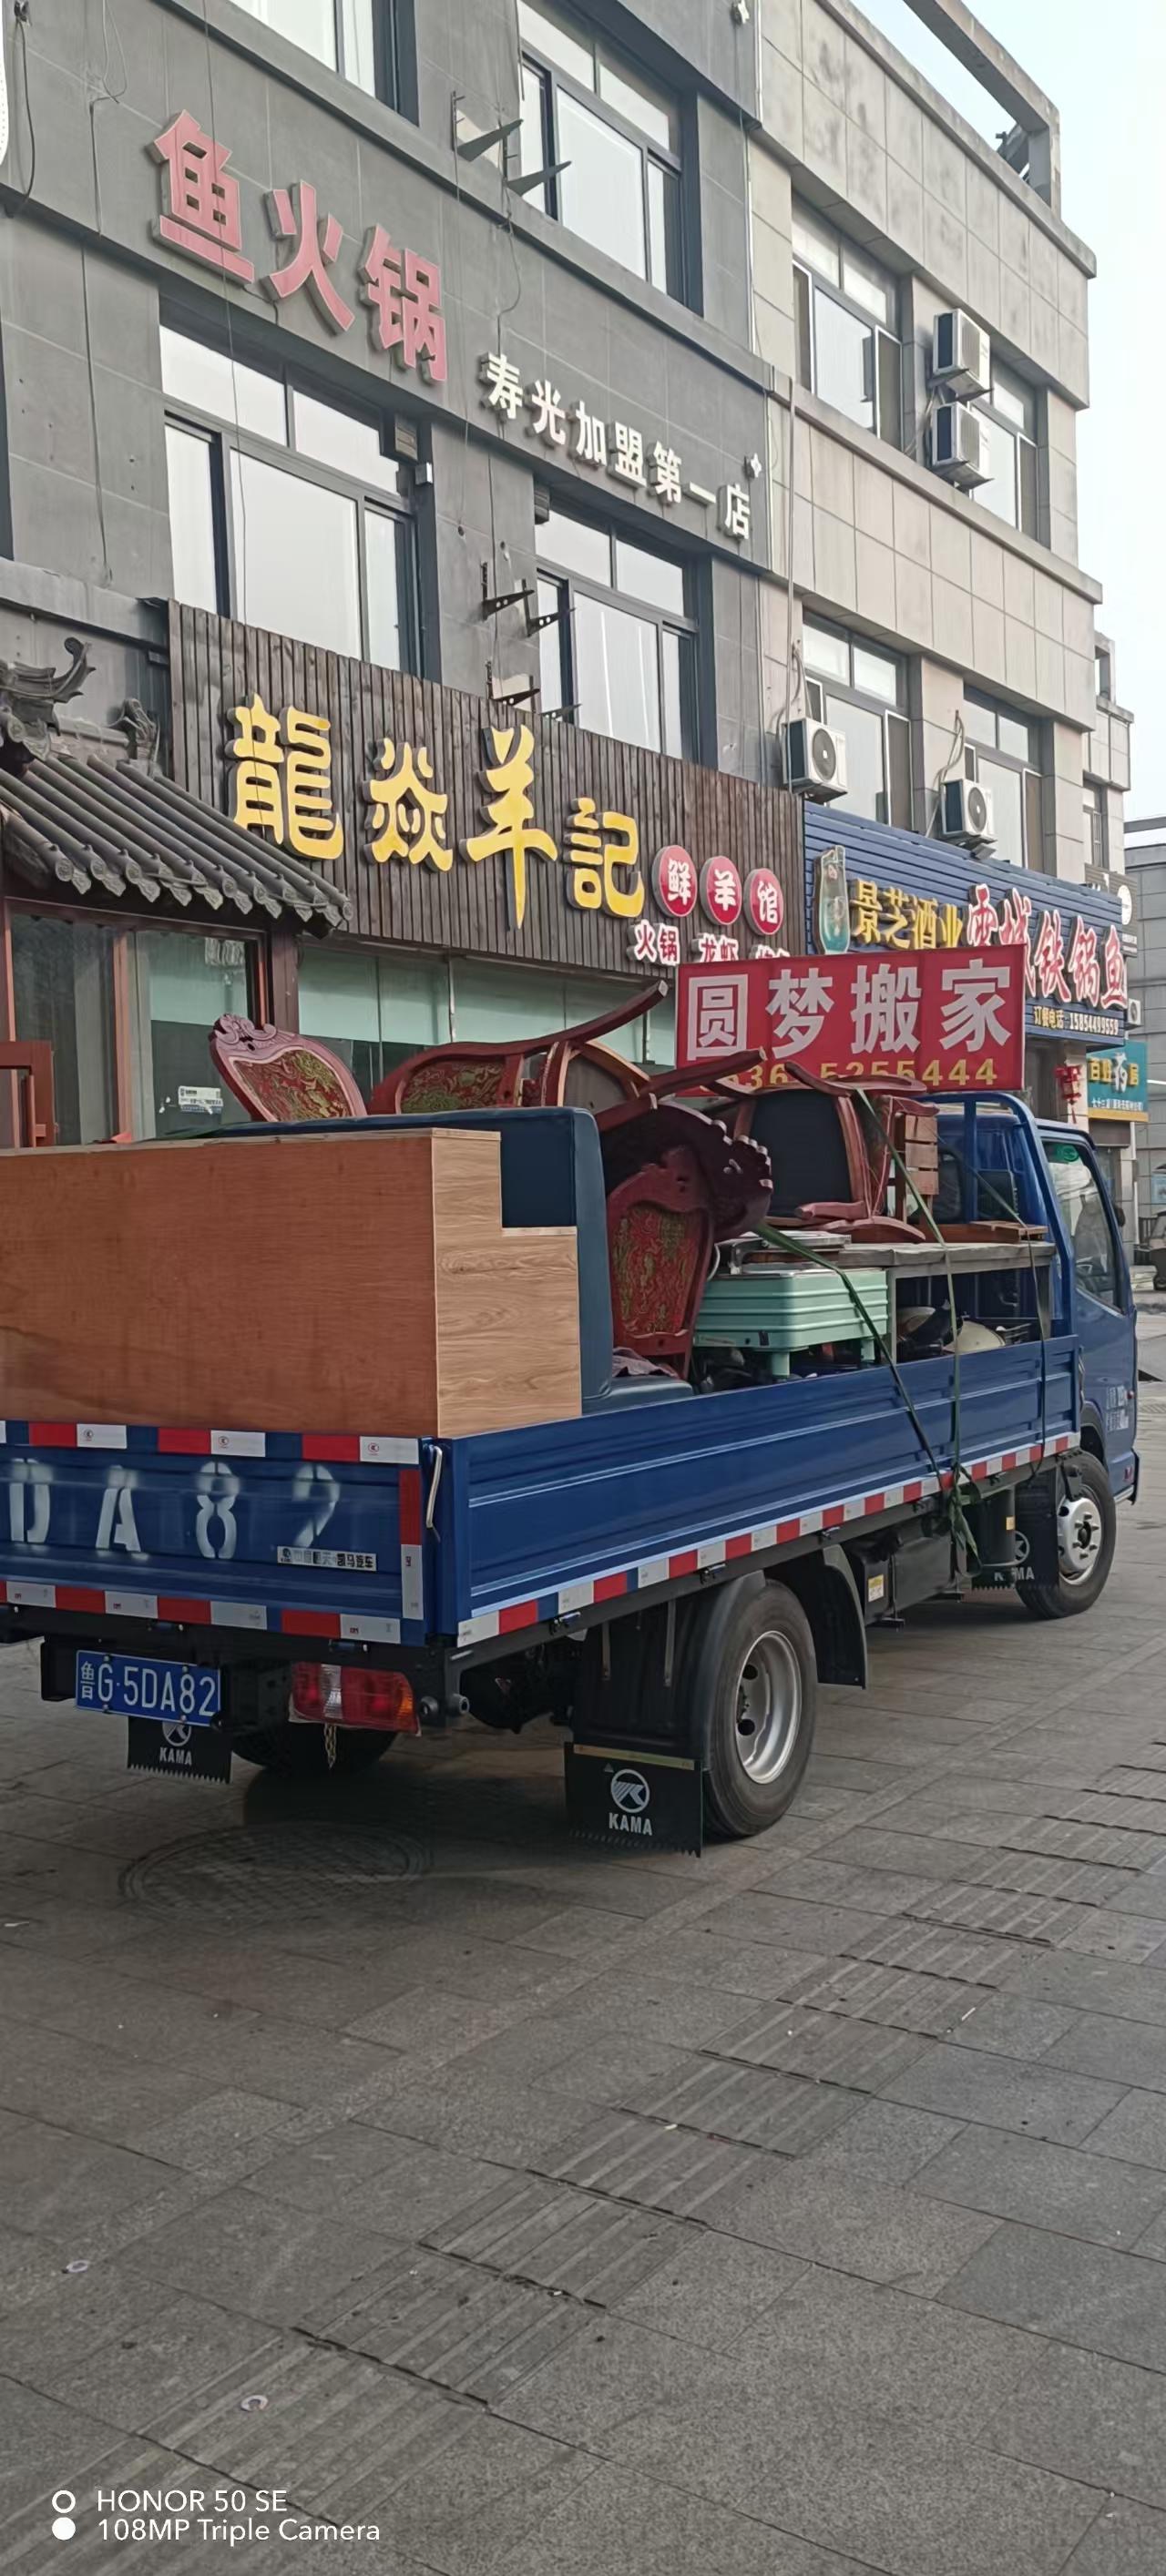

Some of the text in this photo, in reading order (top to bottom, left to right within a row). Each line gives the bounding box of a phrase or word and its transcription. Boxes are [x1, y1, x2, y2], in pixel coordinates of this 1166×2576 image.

[153, 108, 448, 382] 鱼火锅
[486, 351, 751, 541] 寿光加盟第一店
[667, 856, 779, 925] 鲜羊馆
[850, 878, 964, 951] 景芝酒业
[634, 918, 681, 967] 火锅
[686, 957, 1013, 1062] 圆梦搬家
[993, 1566, 1036, 1583] KMA
[159, 1746, 193, 1767] KAMA
[608, 1811, 654, 1837] KAMA
